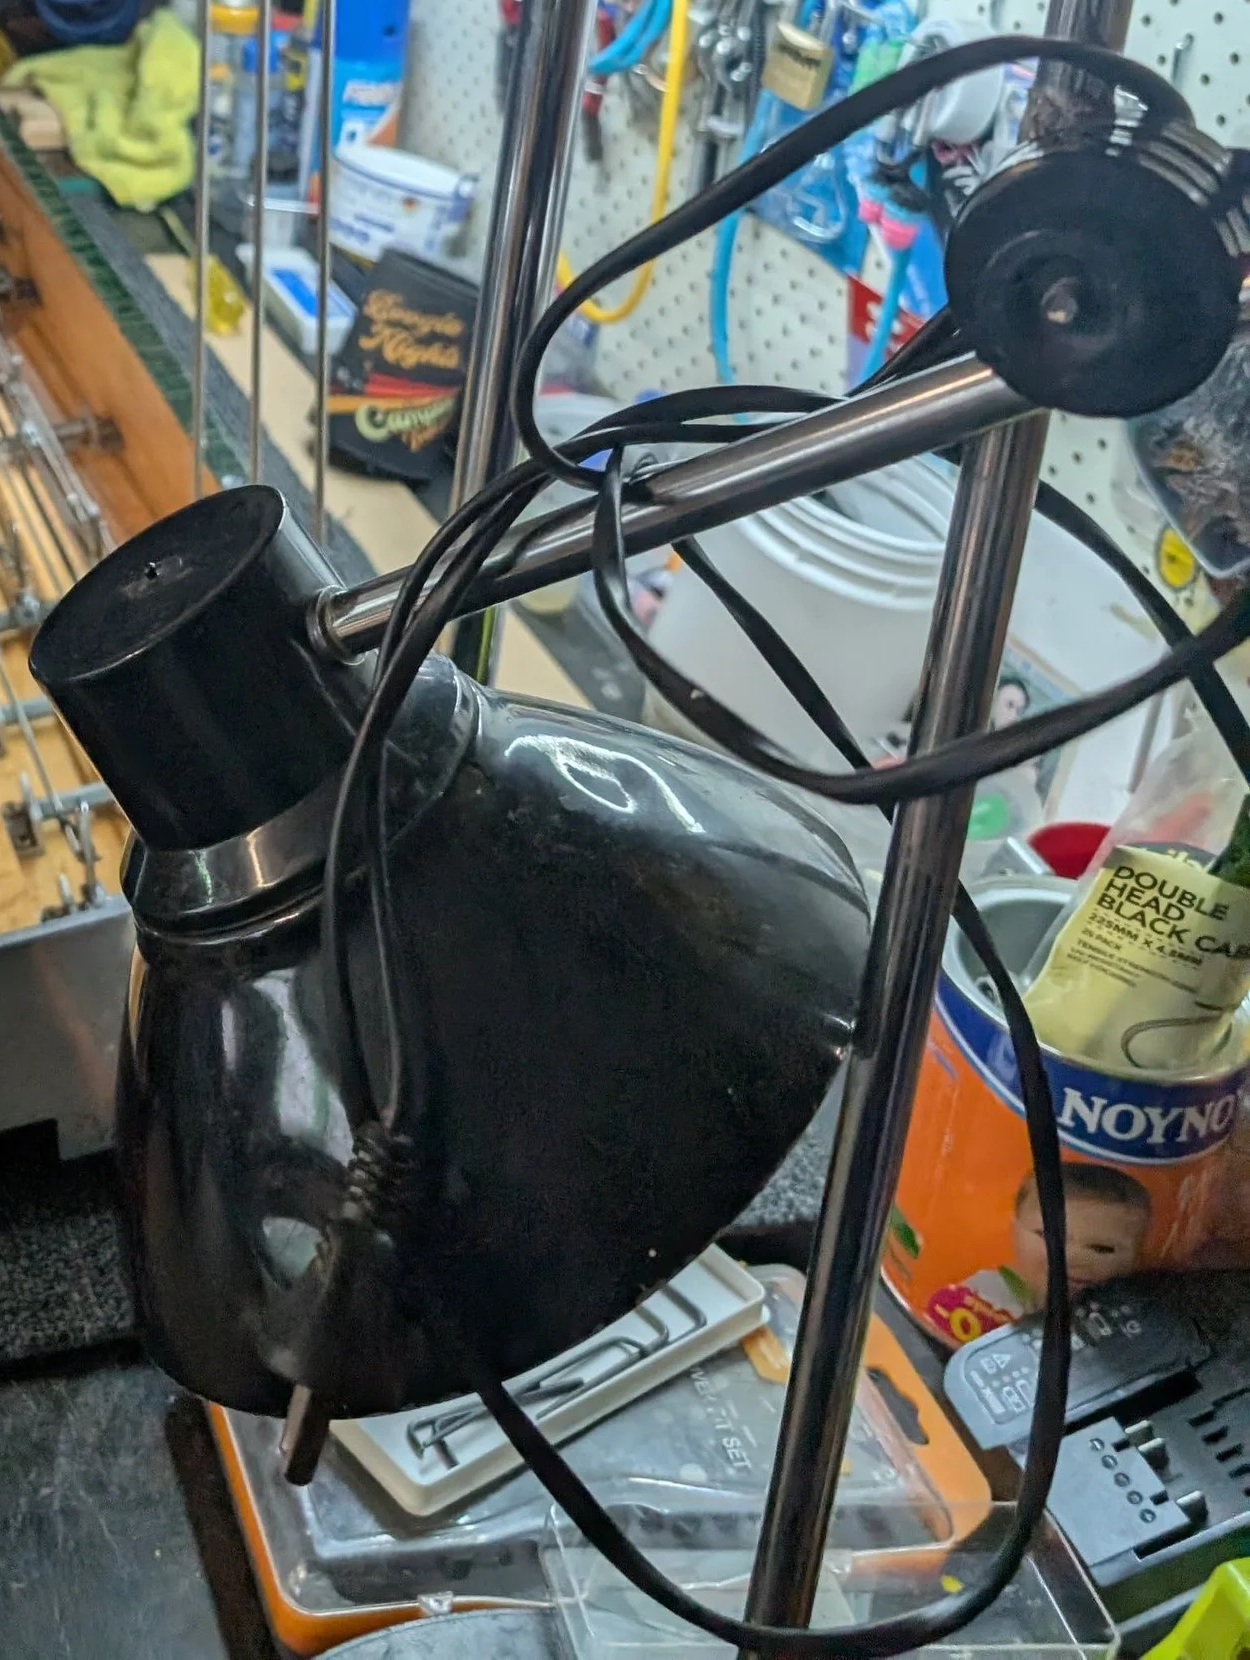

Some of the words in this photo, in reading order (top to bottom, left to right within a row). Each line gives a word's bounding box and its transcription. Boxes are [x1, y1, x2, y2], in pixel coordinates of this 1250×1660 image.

[1097, 893, 1190, 944] BLACK
[1104, 878, 1185, 921] HEAD
[1114, 866, 1229, 920] DOUBLE
